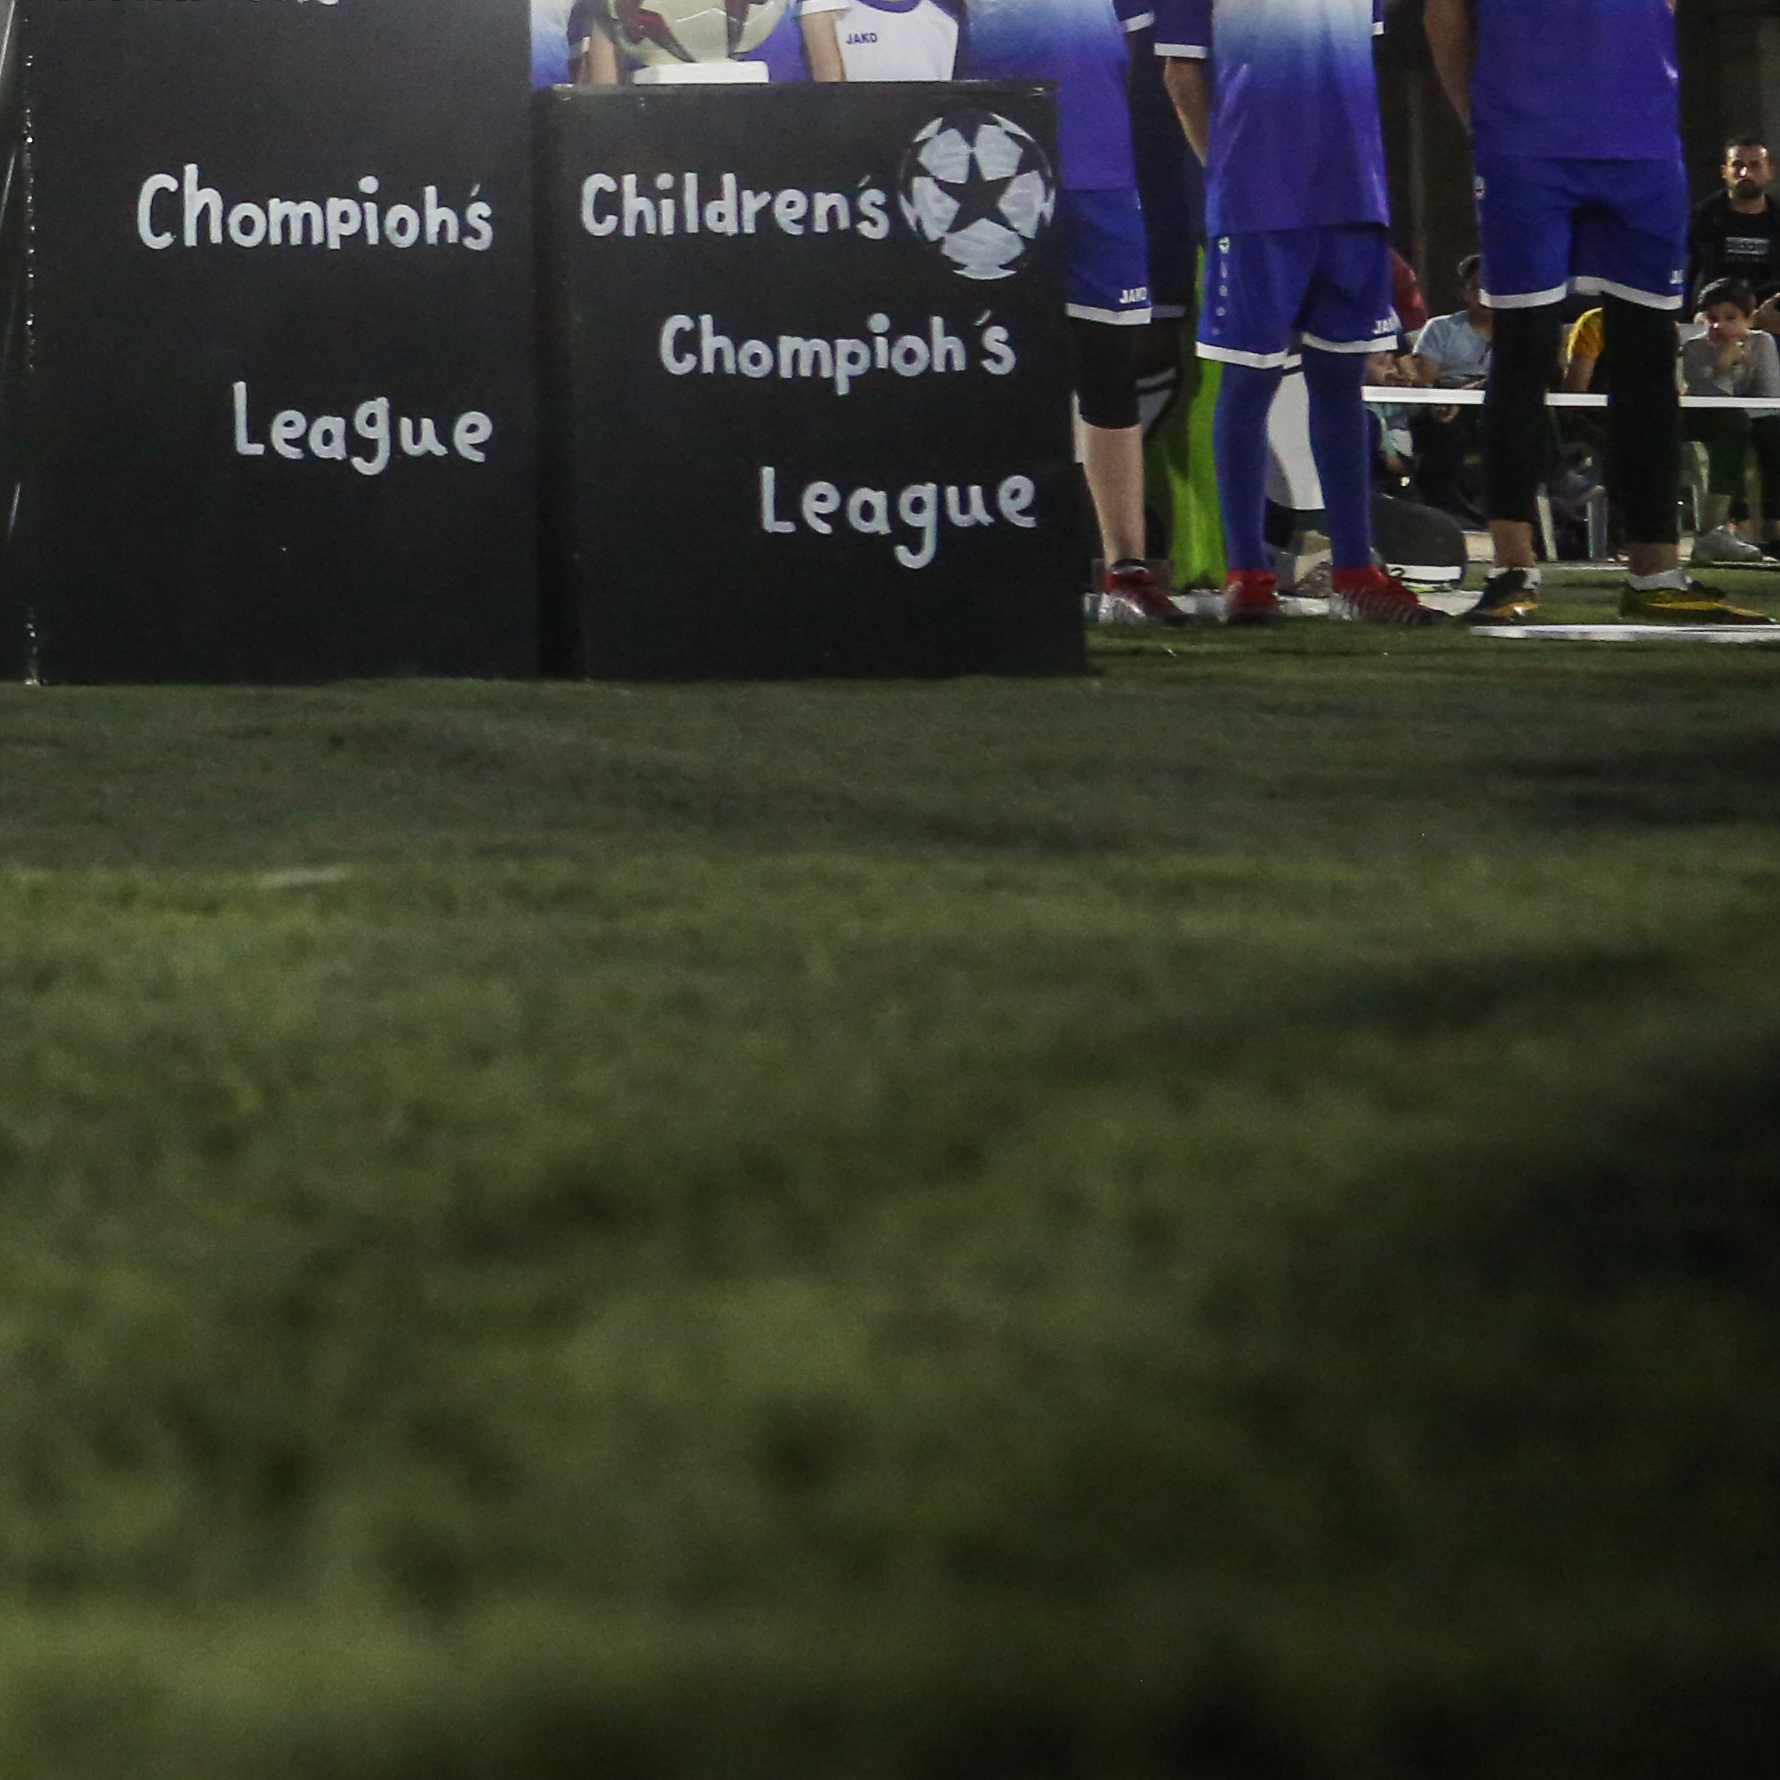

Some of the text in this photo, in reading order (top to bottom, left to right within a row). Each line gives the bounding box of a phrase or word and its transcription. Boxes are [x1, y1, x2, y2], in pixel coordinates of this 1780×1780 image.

[846, 32, 878, 45] JAKO
[232, 380, 493, 476] League
[759, 464, 1038, 570] League
